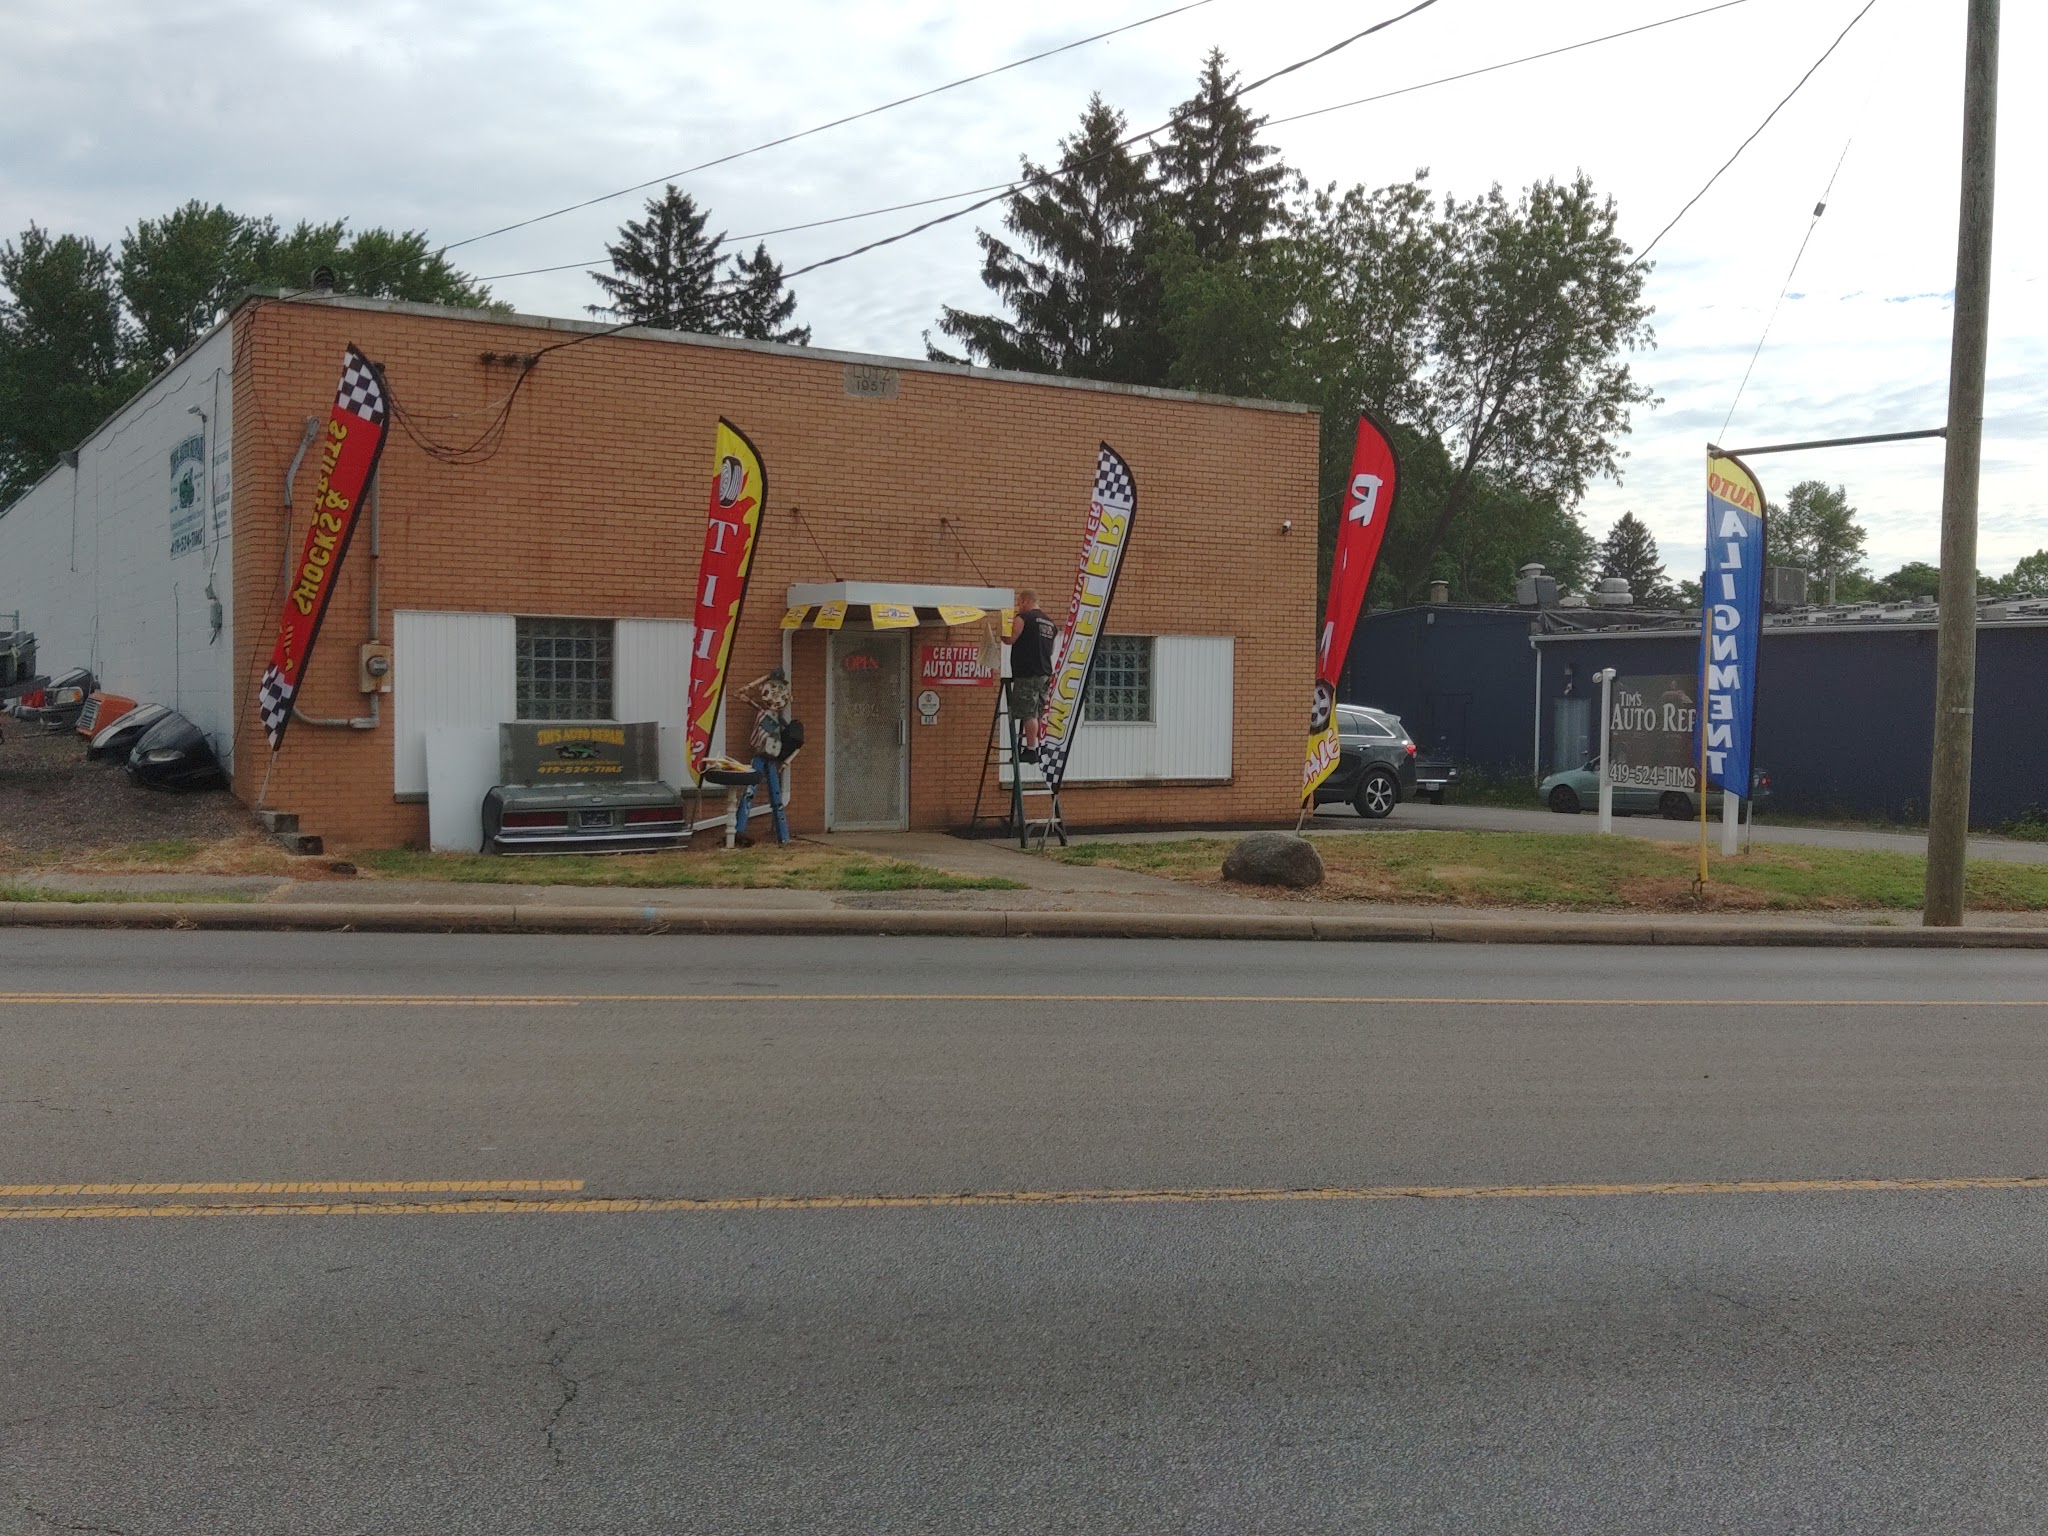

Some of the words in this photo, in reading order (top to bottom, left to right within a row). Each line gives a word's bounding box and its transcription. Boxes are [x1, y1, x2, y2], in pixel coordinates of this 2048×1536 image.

[853, 365, 890, 381] LUTZ
[857, 380, 886, 392] 1957
[933, 647, 978, 661] CERTIFIE
[923, 661, 952, 678] AUTO
[1619, 691, 1642, 707] TIM'S
[1610, 703, 1657, 731] AUTO
[1303, 727, 1340, 786] ALE
[1609, 763, 1697, 787] 419-524-TIMS
